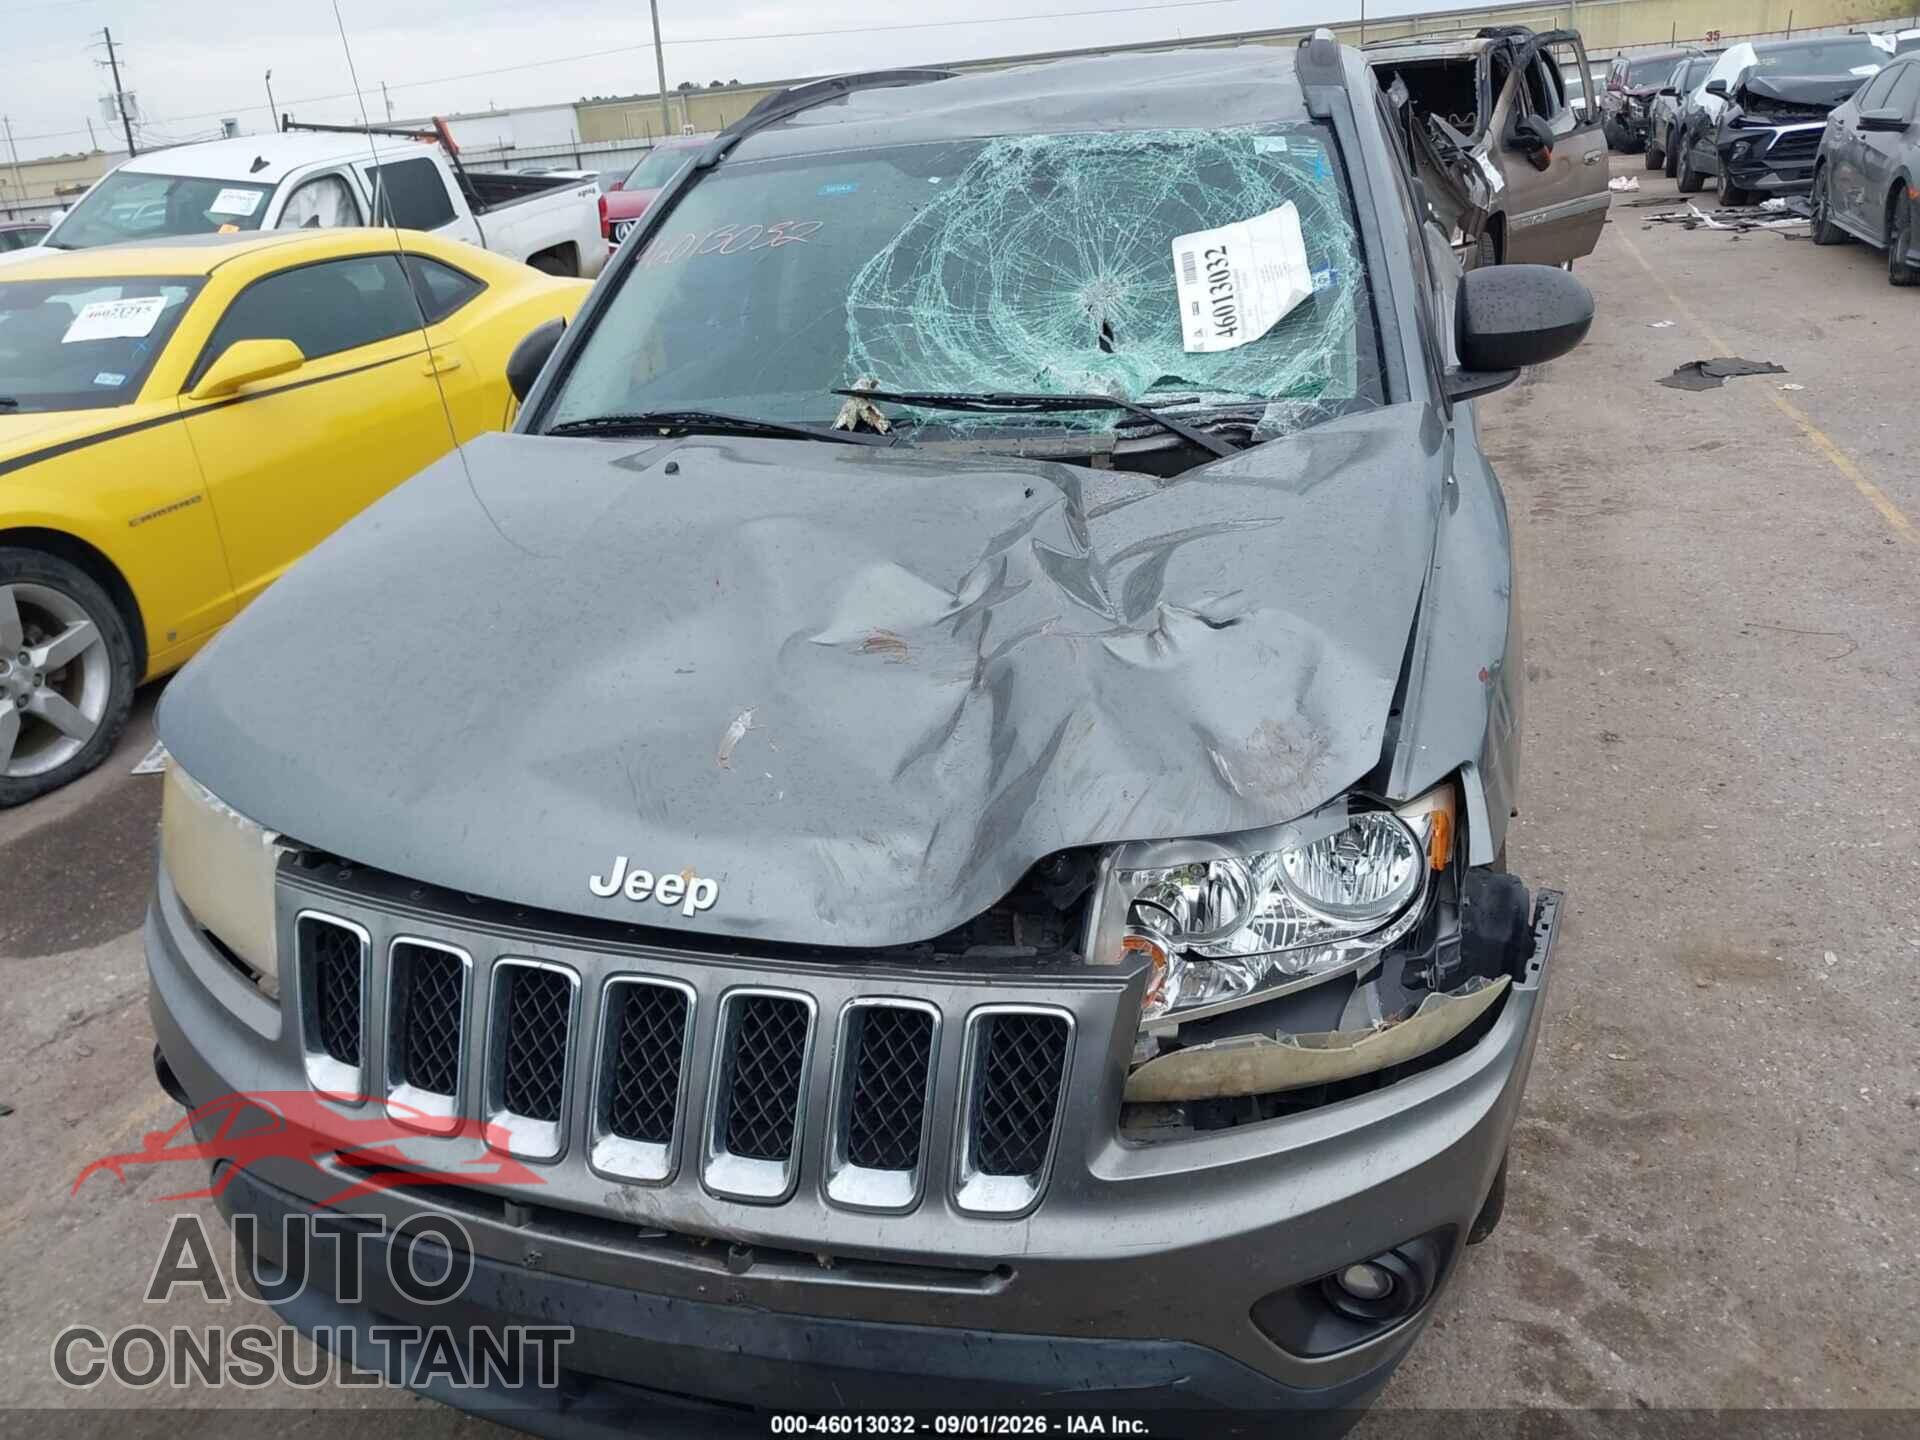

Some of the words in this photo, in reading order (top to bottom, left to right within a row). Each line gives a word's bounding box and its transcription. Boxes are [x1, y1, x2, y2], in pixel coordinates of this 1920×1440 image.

[1705, 30, 1721, 42] 35
[1204, 245, 1239, 338] 46013032
[589, 855, 719, 918] Jeep
